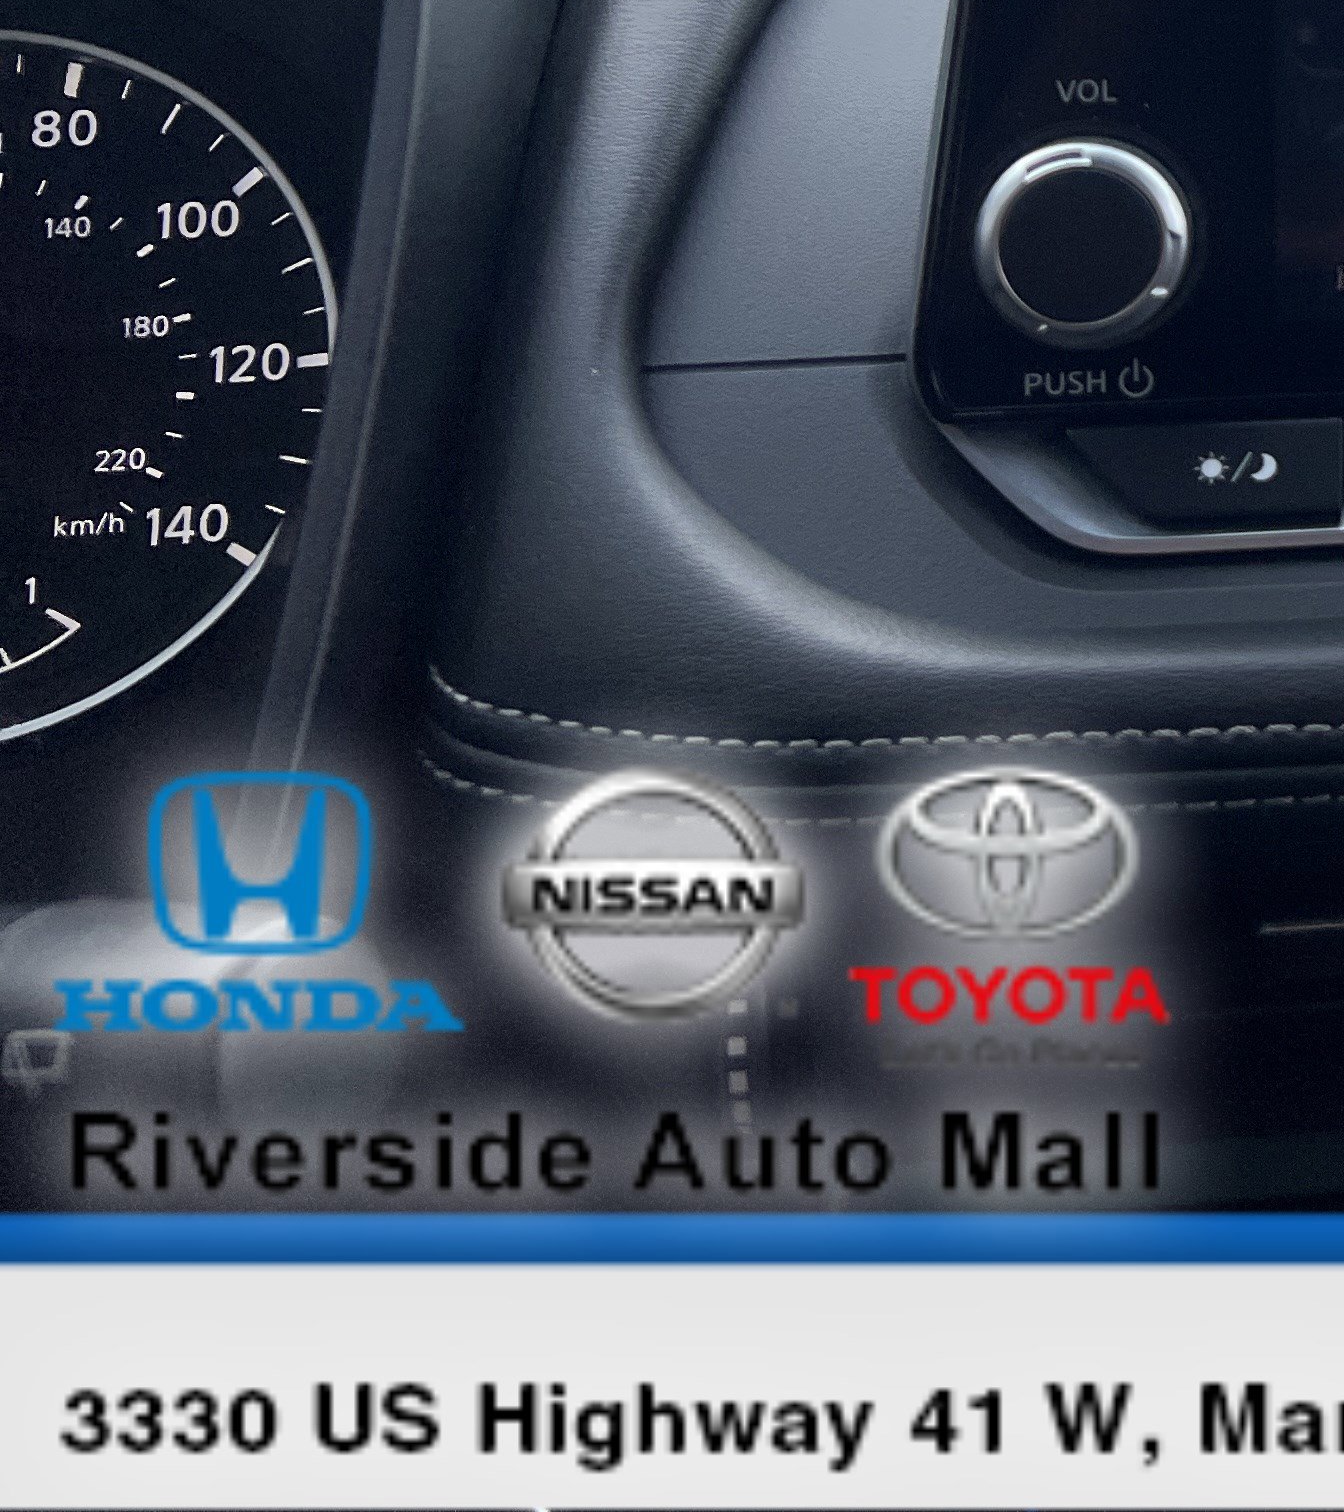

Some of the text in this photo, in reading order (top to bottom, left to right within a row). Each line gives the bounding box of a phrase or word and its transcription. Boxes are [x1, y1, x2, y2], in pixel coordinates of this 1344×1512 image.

[1056, 79, 1117, 103] VOL
[32, 109, 98, 148] 80
[45, 214, 92, 239] 140
[157, 200, 240, 239] 100
[122, 315, 169, 339] 180
[210, 341, 290, 383] 120
[1024, 370, 1106, 396] PUSH
[94, 447, 146, 473] 220
[53, 511, 126, 537] km/h
[146, 503, 229, 546] 140
